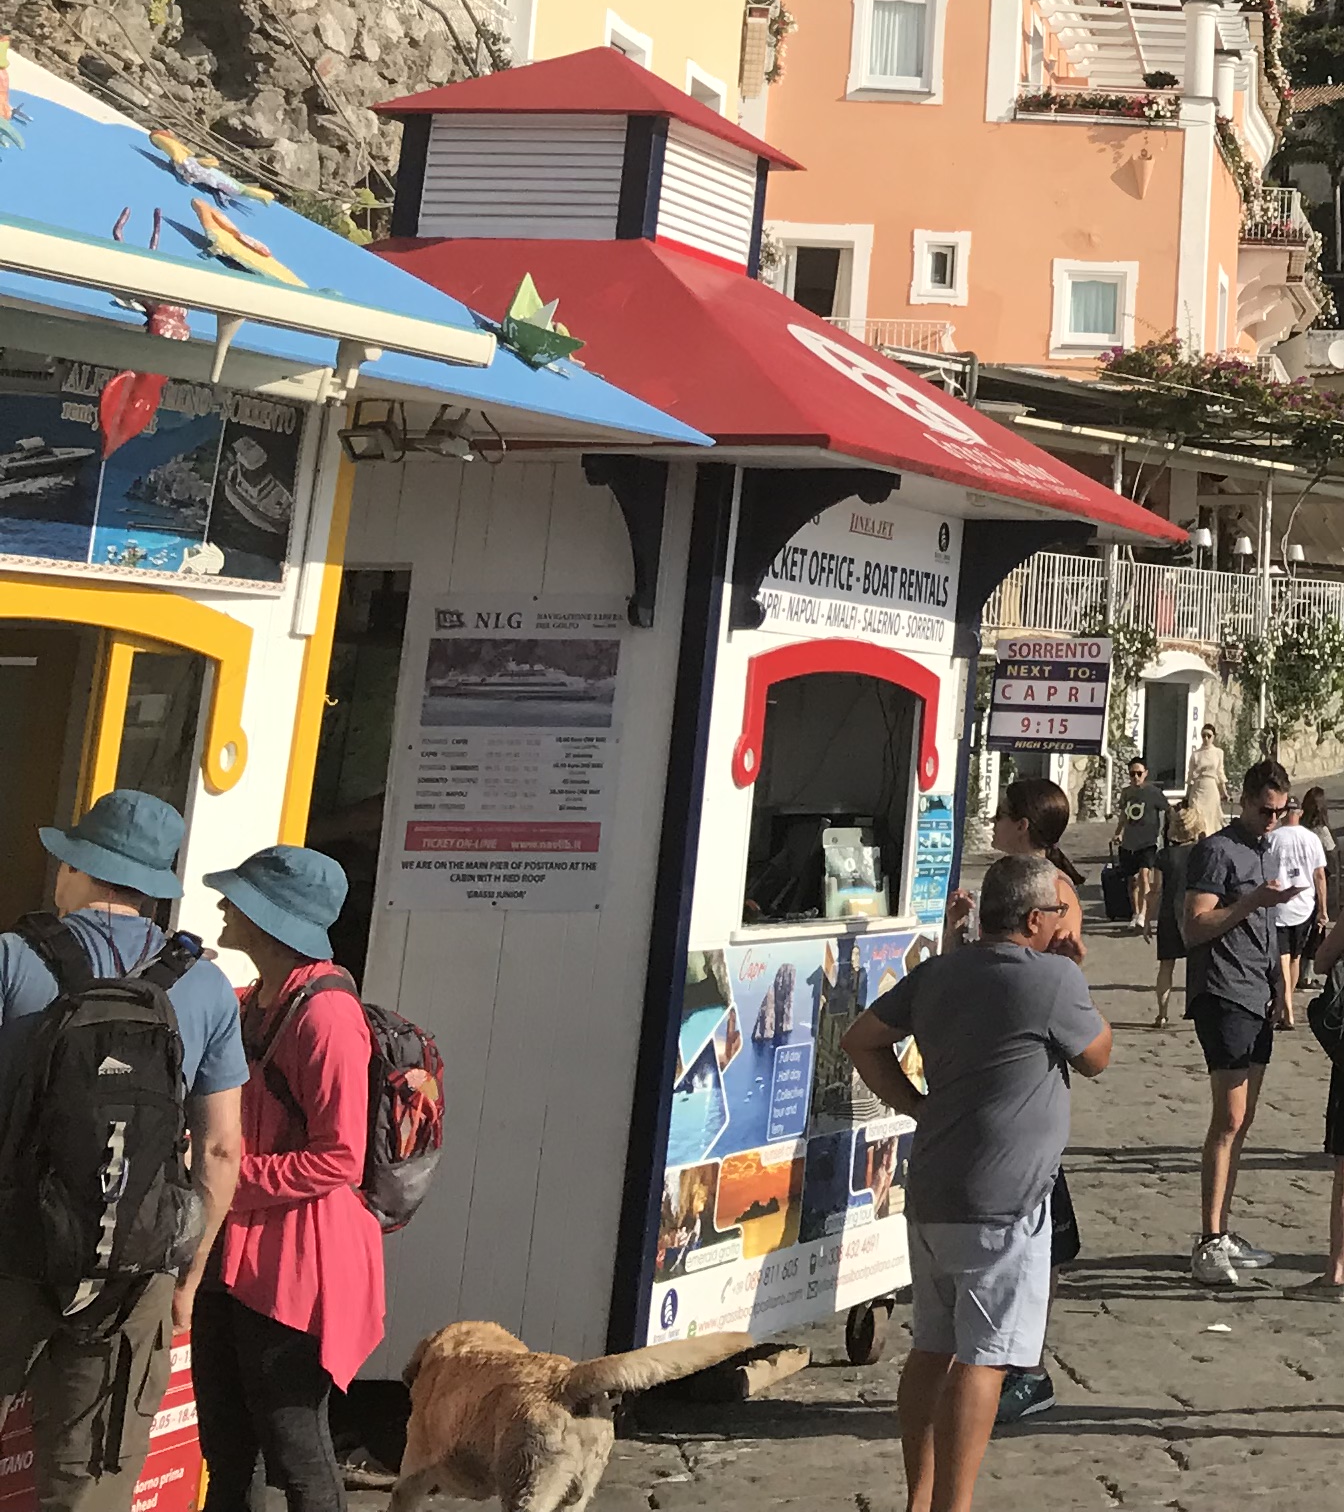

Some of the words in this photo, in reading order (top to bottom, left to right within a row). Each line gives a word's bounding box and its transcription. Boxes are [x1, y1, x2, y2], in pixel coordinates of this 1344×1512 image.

[850, 512, 876, 535] LINEA
[877, 518, 895, 538] JET
[808, 550, 854, 591] OFFICE
[863, 560, 898, 598] BOAT
[899, 568, 949, 608] RENTALS
[474, 612, 523, 630] NLG
[757, 591, 782, 619] APRI
[786, 598, 820, 624] NAPOLI
[825, 602, 858, 630] AMALFI
[862, 608, 900, 636] SALERNO
[905, 614, 944, 643] SORRENTO
[1008, 642, 1101, 659] SORRENTO
[1006, 664, 1052, 678] NEXT
[1068, 667, 1097, 679] TO:
[1001, 683, 1095, 703] CAPRI
[1021, 717, 1069, 735] 9:15
[1014, 740, 1041, 749] HIGH
[1042, 741, 1074, 750] SPEED
[422, 838, 454, 849] TICKET
[401, 861, 414, 870] WE
[415, 861, 432, 870] ARE
[434, 861, 447, 870] ON
[449, 861, 464, 870] THE
[466, 862, 488, 870] MAIN
[489, 862, 509, 870] PIER
[510, 862, 523, 870] OF
[524, 862, 568, 871] POSITANO
[569, 862, 581, 871] AT
[581, 862, 597, 871] THE
[450, 874, 476, 883] CABIN
[503, 874, 520, 883] RED
[522, 874, 546, 883] ROOF
[739, 948, 771, 982] Capri
[790, 1069, 802, 1082] day
[786, 1104, 797, 1115] and
[160, 1467, 185, 1490] prima
